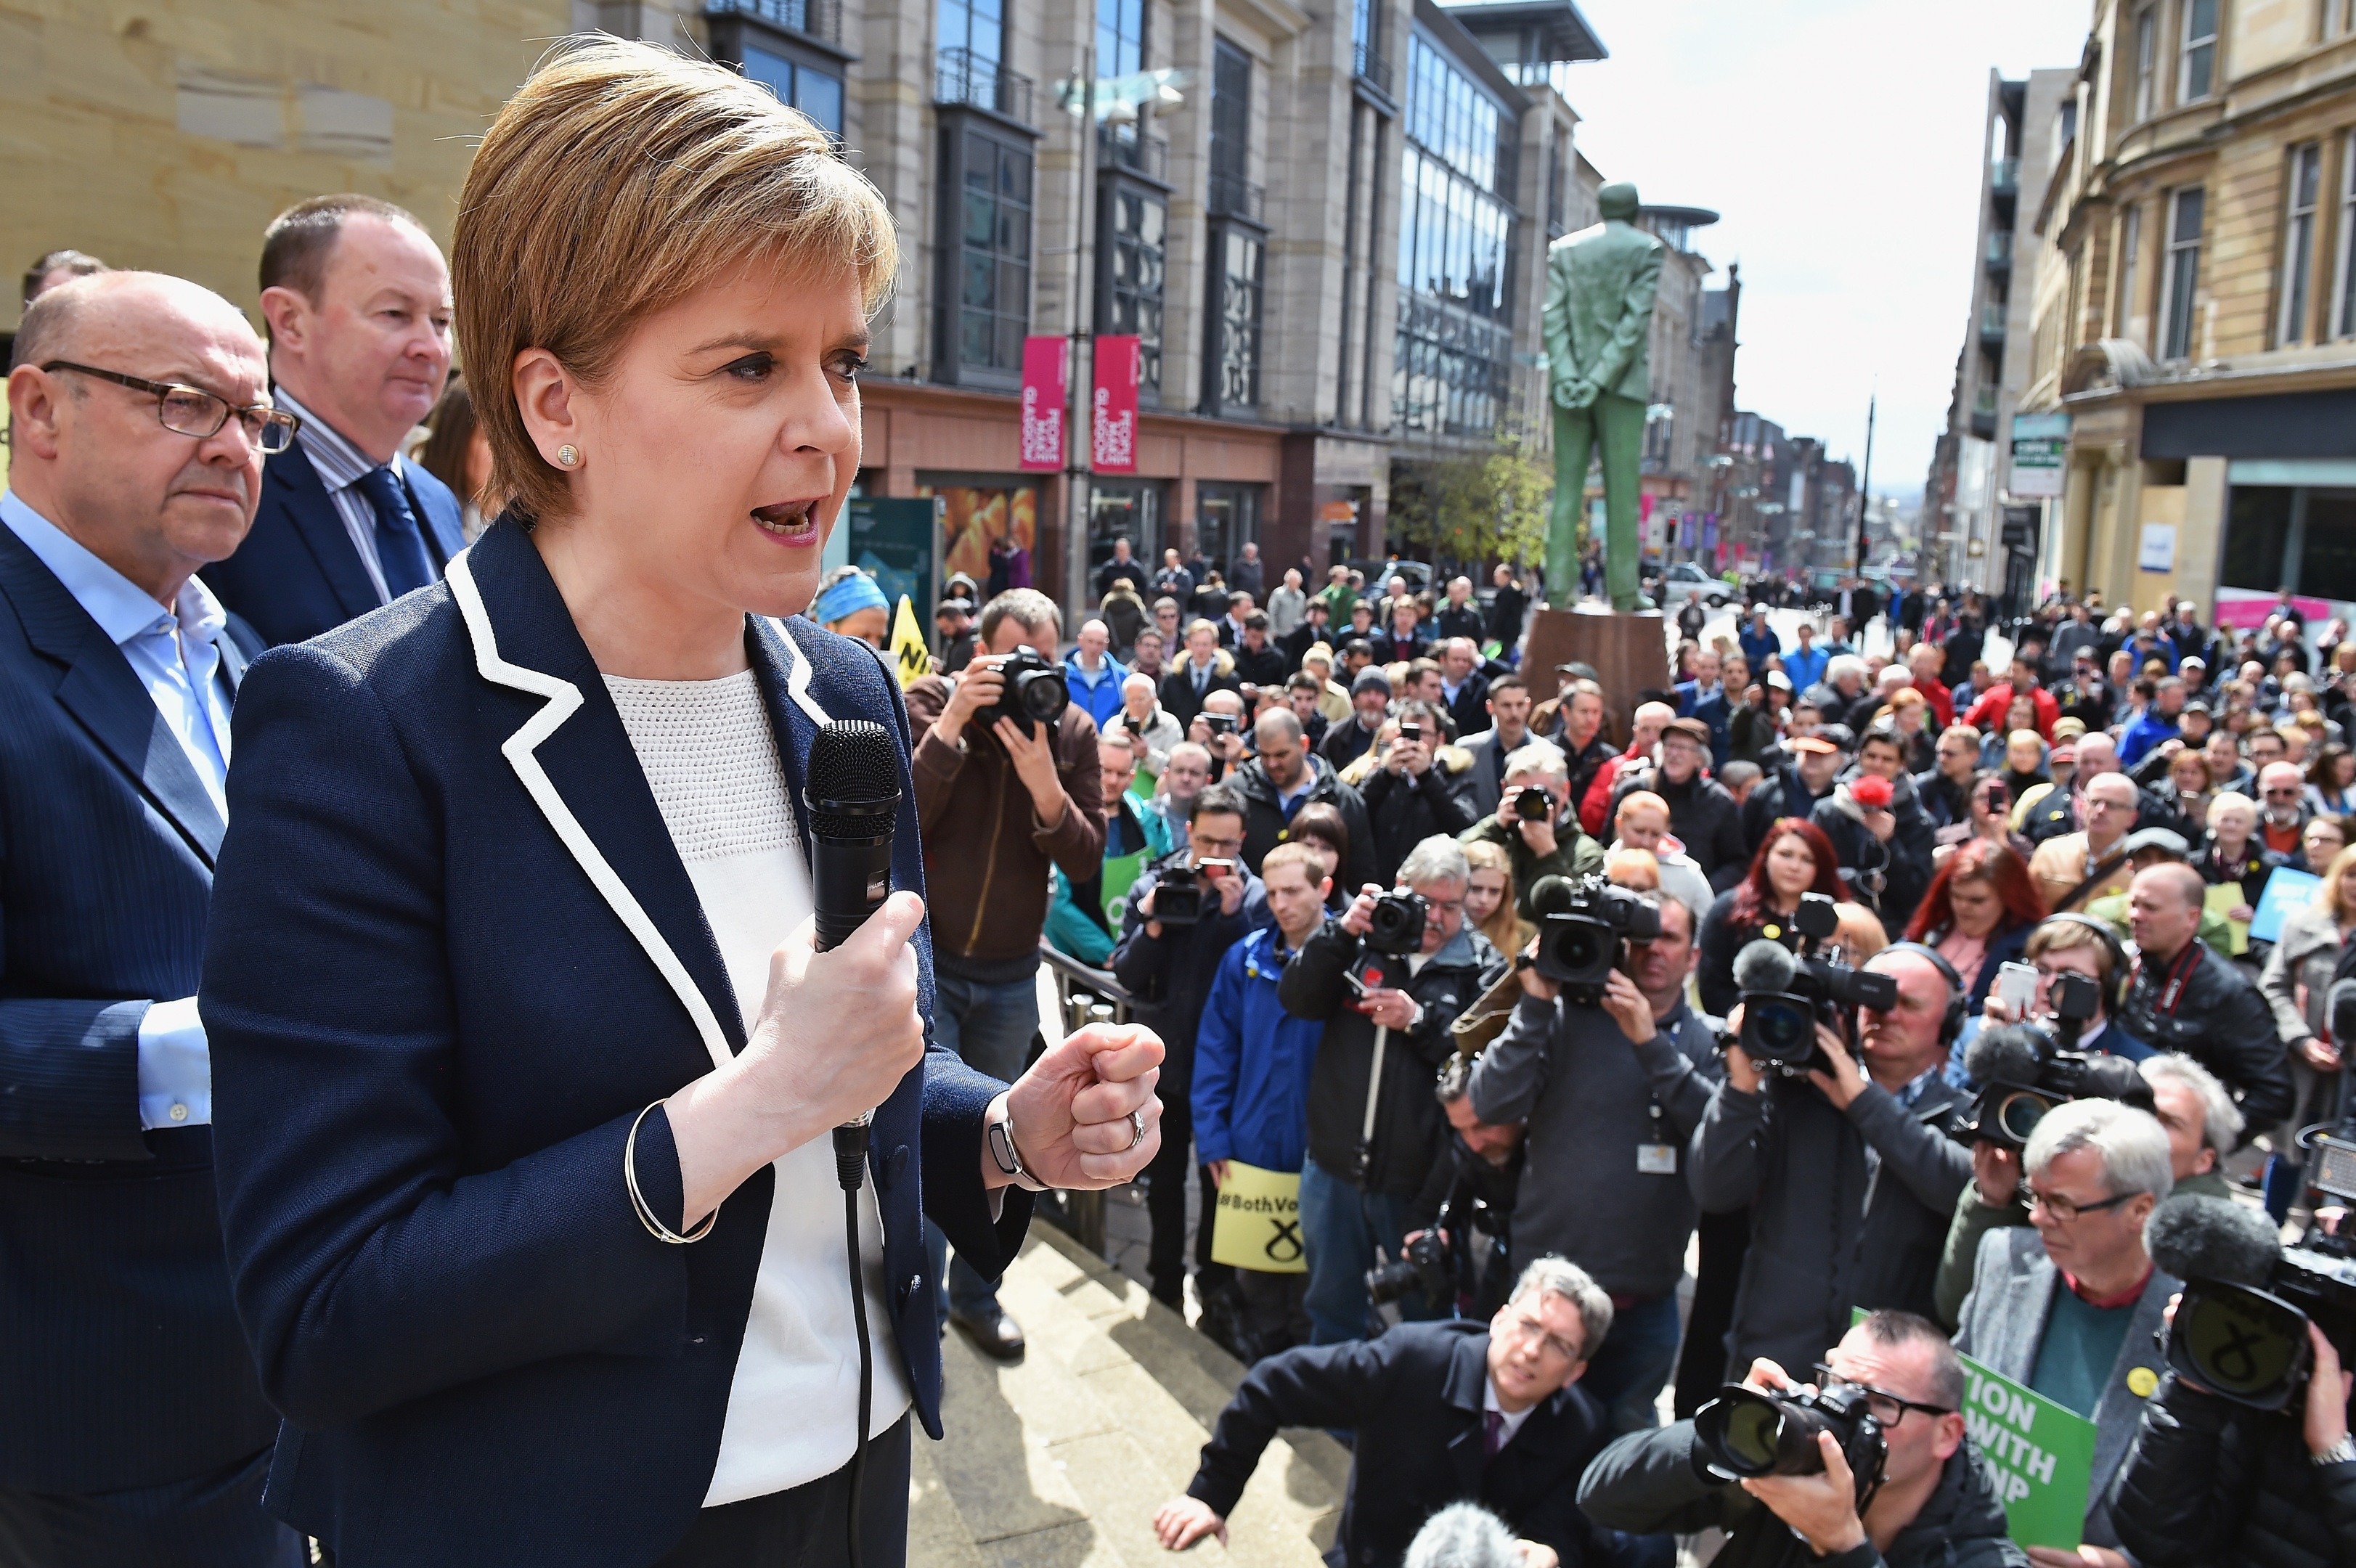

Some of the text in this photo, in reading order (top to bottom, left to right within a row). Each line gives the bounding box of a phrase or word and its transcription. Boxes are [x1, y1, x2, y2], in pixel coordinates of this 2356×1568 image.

[1022, 385, 1037, 462] GLASGOW
[1047, 408, 1060, 462] PEOPLE
[1095, 388, 1109, 464] GLASGOW
[1119, 410, 1132, 465] PEOPLE
[1965, 1406, 2058, 1486] WITH
